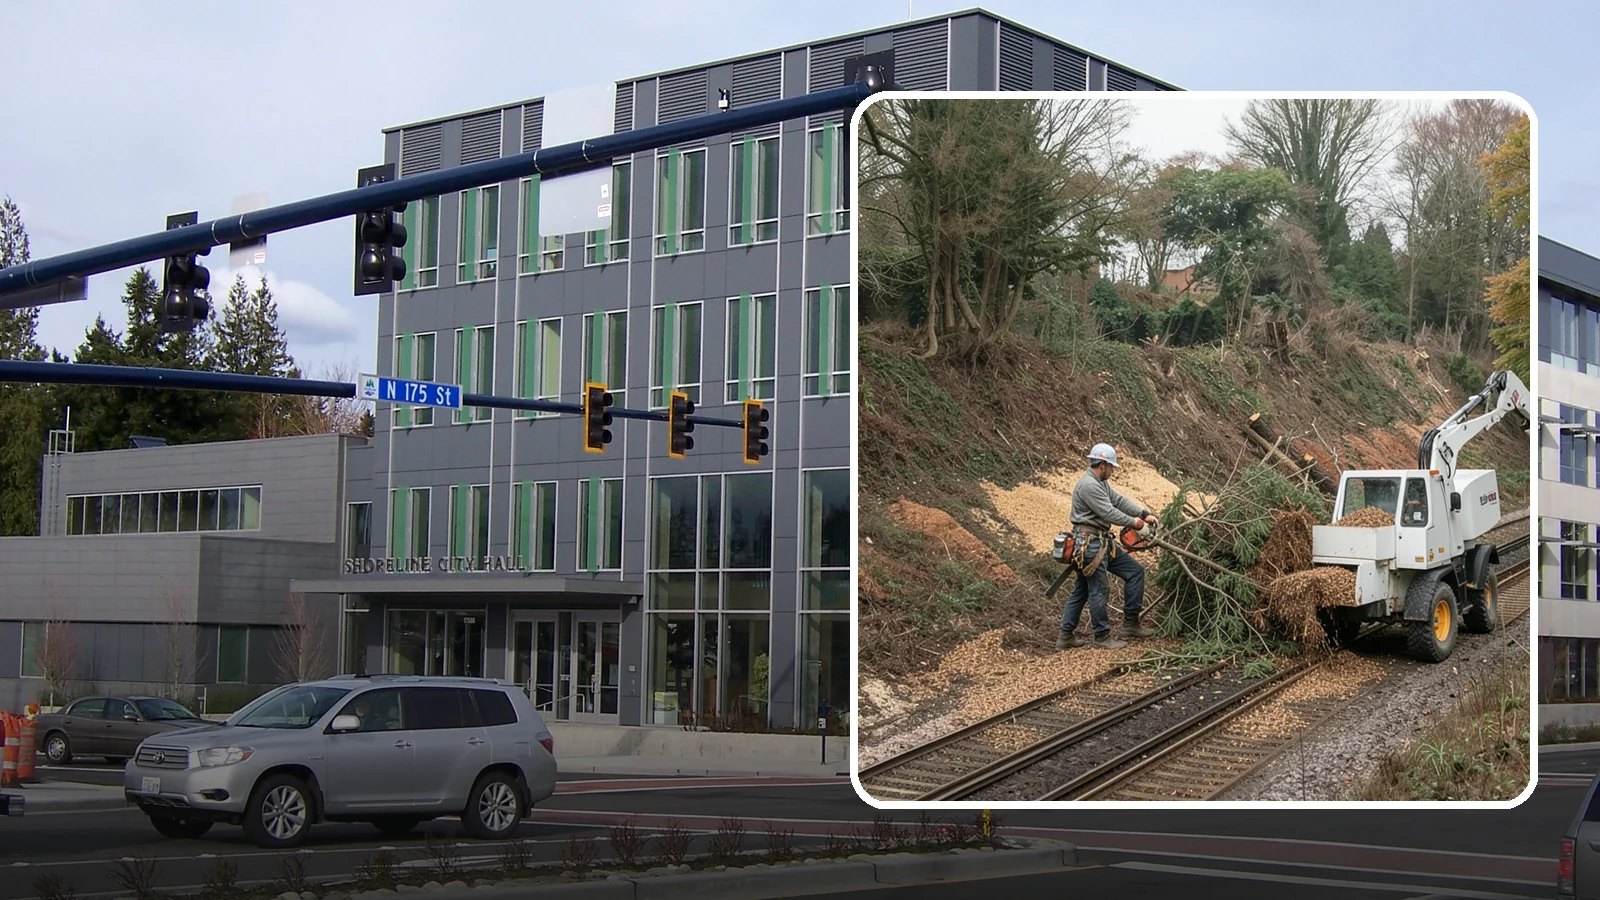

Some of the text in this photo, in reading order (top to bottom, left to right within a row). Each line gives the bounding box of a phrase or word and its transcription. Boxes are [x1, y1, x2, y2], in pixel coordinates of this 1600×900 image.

[387, 381, 452, 406] N 175 St
[344, 555, 526, 574] SHORELINE CITY HALL
